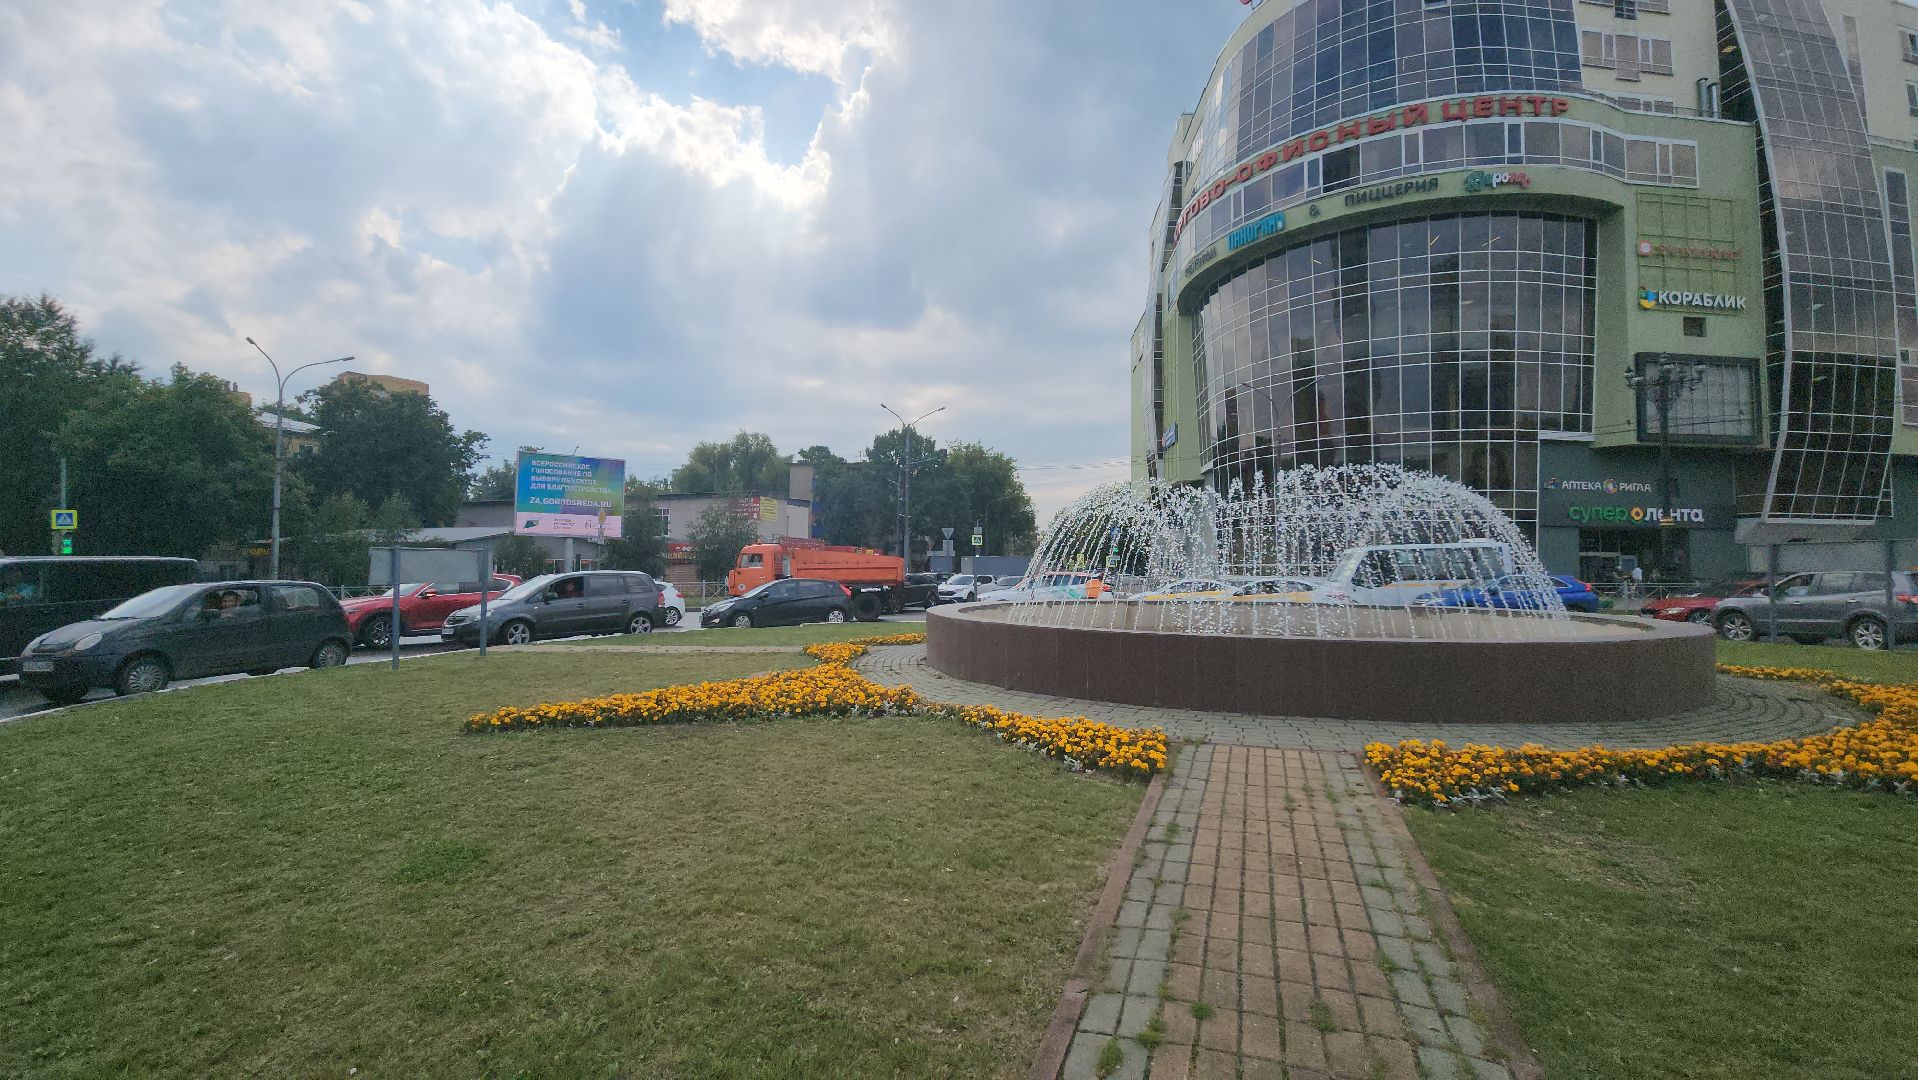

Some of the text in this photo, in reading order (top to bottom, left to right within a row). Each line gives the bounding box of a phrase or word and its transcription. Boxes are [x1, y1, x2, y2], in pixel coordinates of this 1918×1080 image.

[1441, 95, 1569, 123] ЦЕНТР
[1344, 177, 1439, 207] ПИЦЦЕРИЯ
[1658, 290, 1746, 310] КОРАБЛИК
[1561, 480, 1650, 492] АПТЕКА РИГЛА
[529, 497, 612, 508] ZA.GORODSREDA.RU
[1567, 505, 1628, 523] супер
